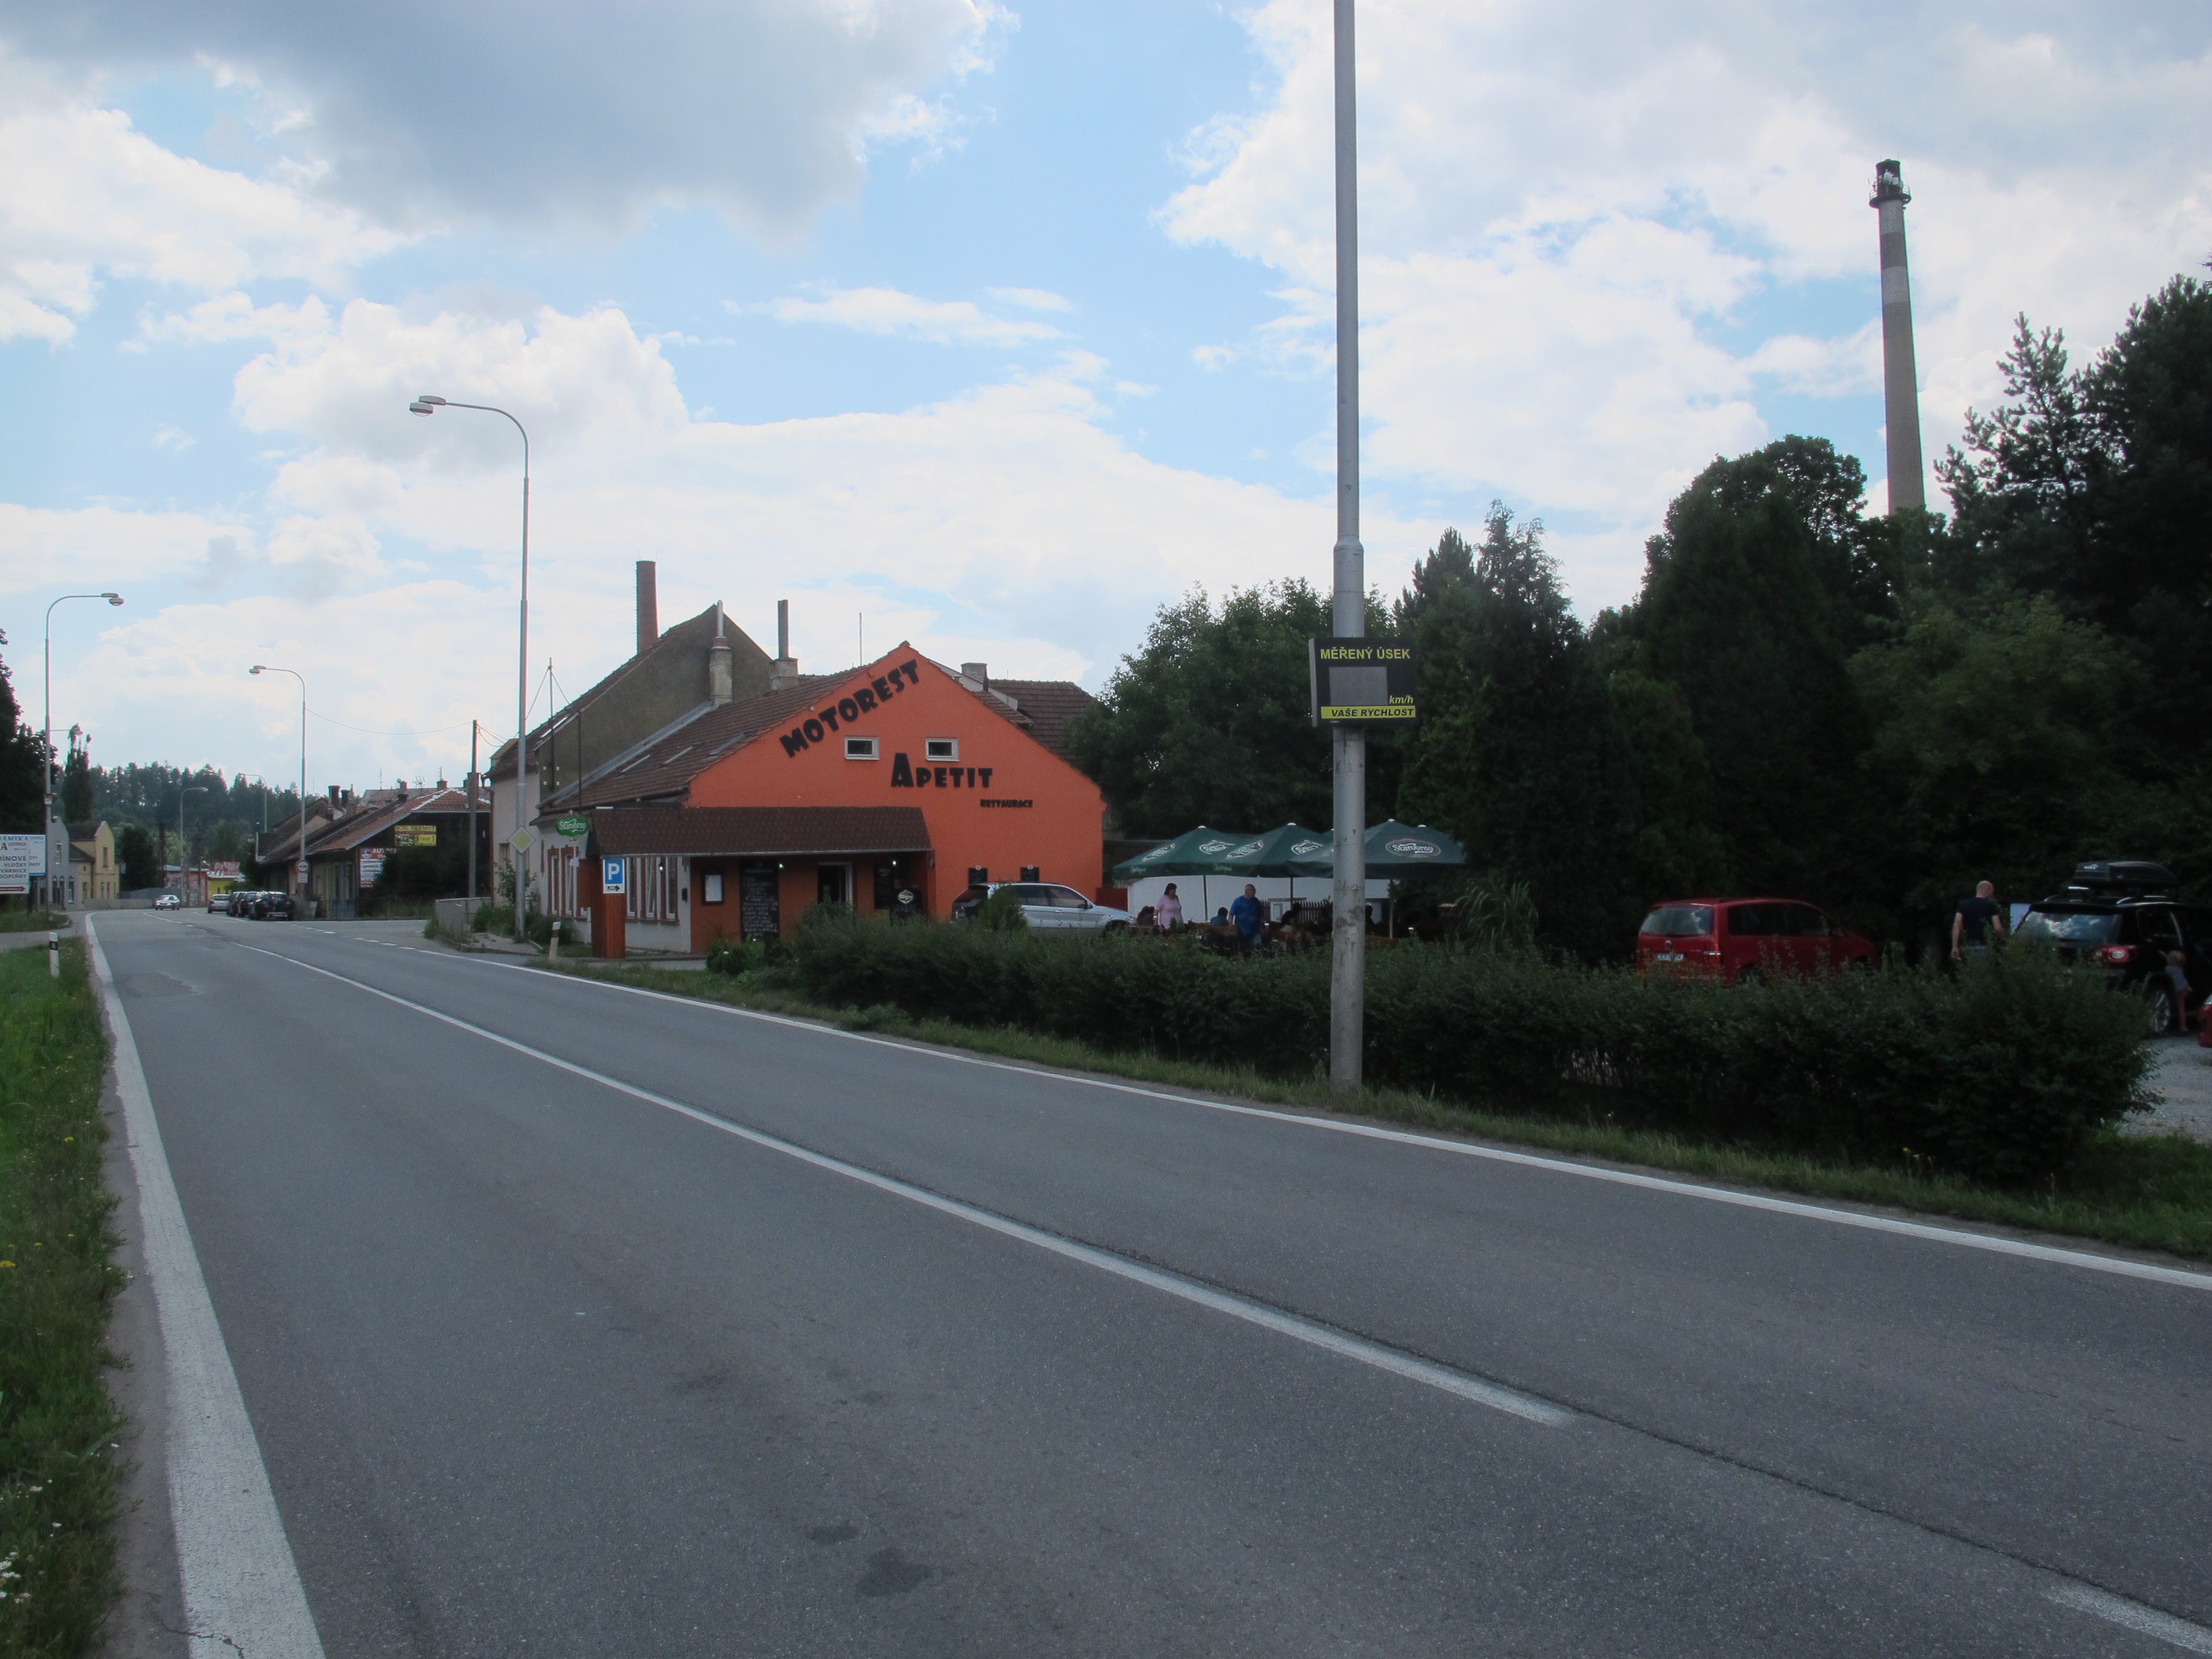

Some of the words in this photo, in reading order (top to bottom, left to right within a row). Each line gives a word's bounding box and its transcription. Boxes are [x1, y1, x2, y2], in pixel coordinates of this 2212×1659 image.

[1320, 647, 1373, 659] MĚŘENÝ
[1377, 647, 1411, 659] ÚSEK
[1389, 695, 1413, 704] km/h
[779, 659, 919, 758] MOTOREST
[1331, 708, 1358, 717] VAŠE
[1361, 708, 1414, 717] RYCHLOST
[891, 752, 993, 788] APETIT
[608, 863, 620, 880] P
